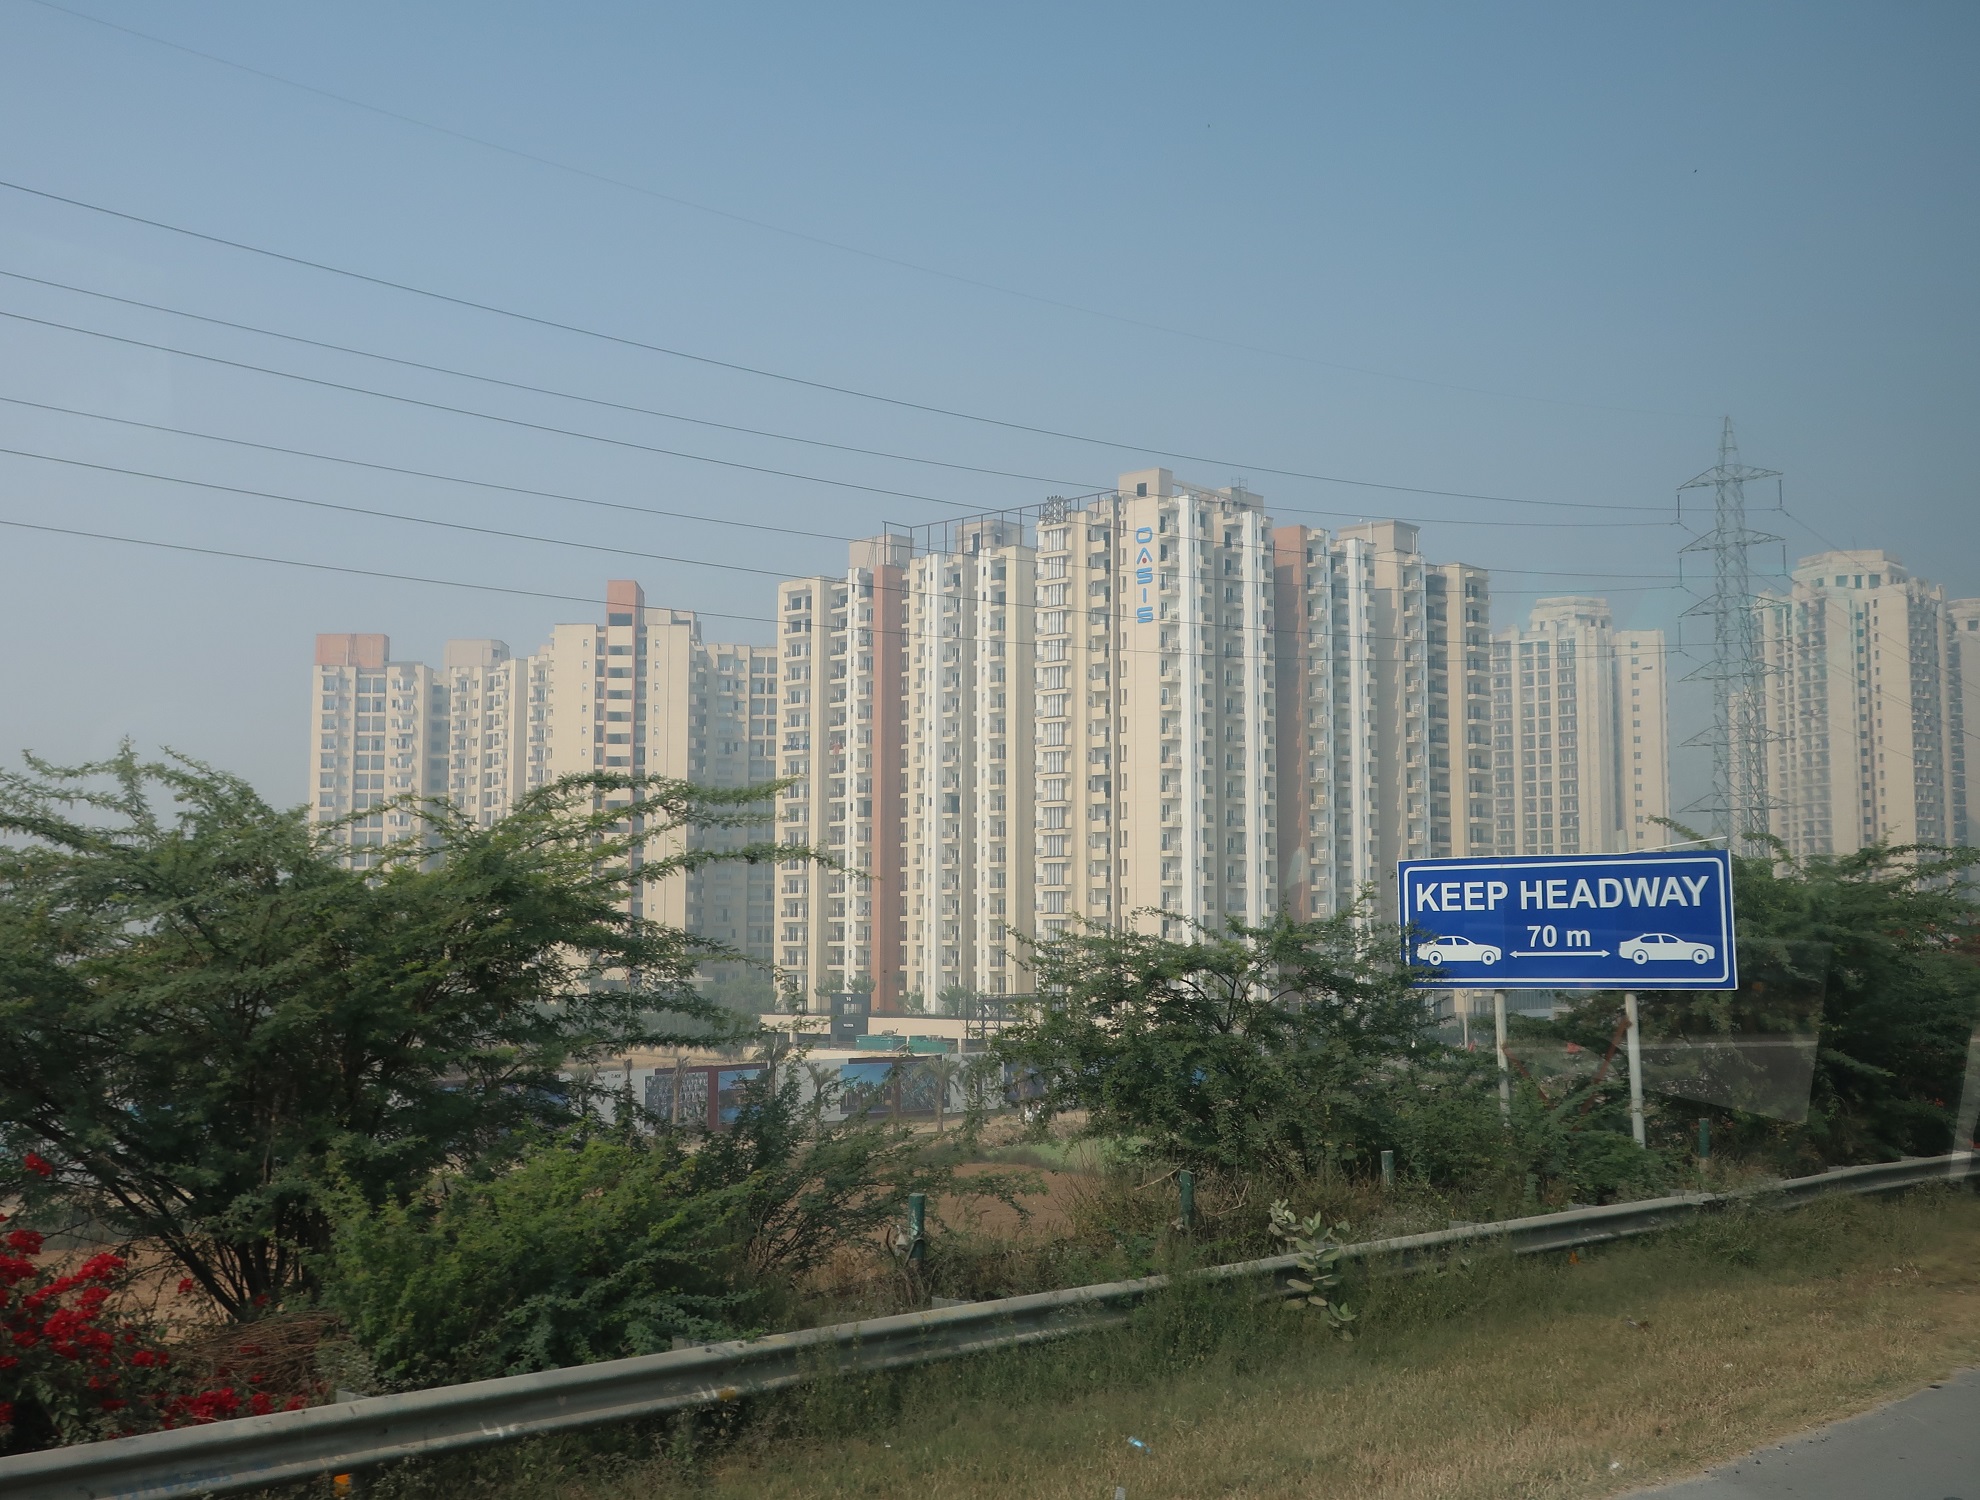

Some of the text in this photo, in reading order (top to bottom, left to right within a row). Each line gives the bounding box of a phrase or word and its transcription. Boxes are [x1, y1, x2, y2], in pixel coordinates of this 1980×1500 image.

[1135, 526, 1154, 624] OASIS
[1416, 875, 1710, 912] KEEP HEADWAY
[1526, 925, 1592, 948] 70 m
